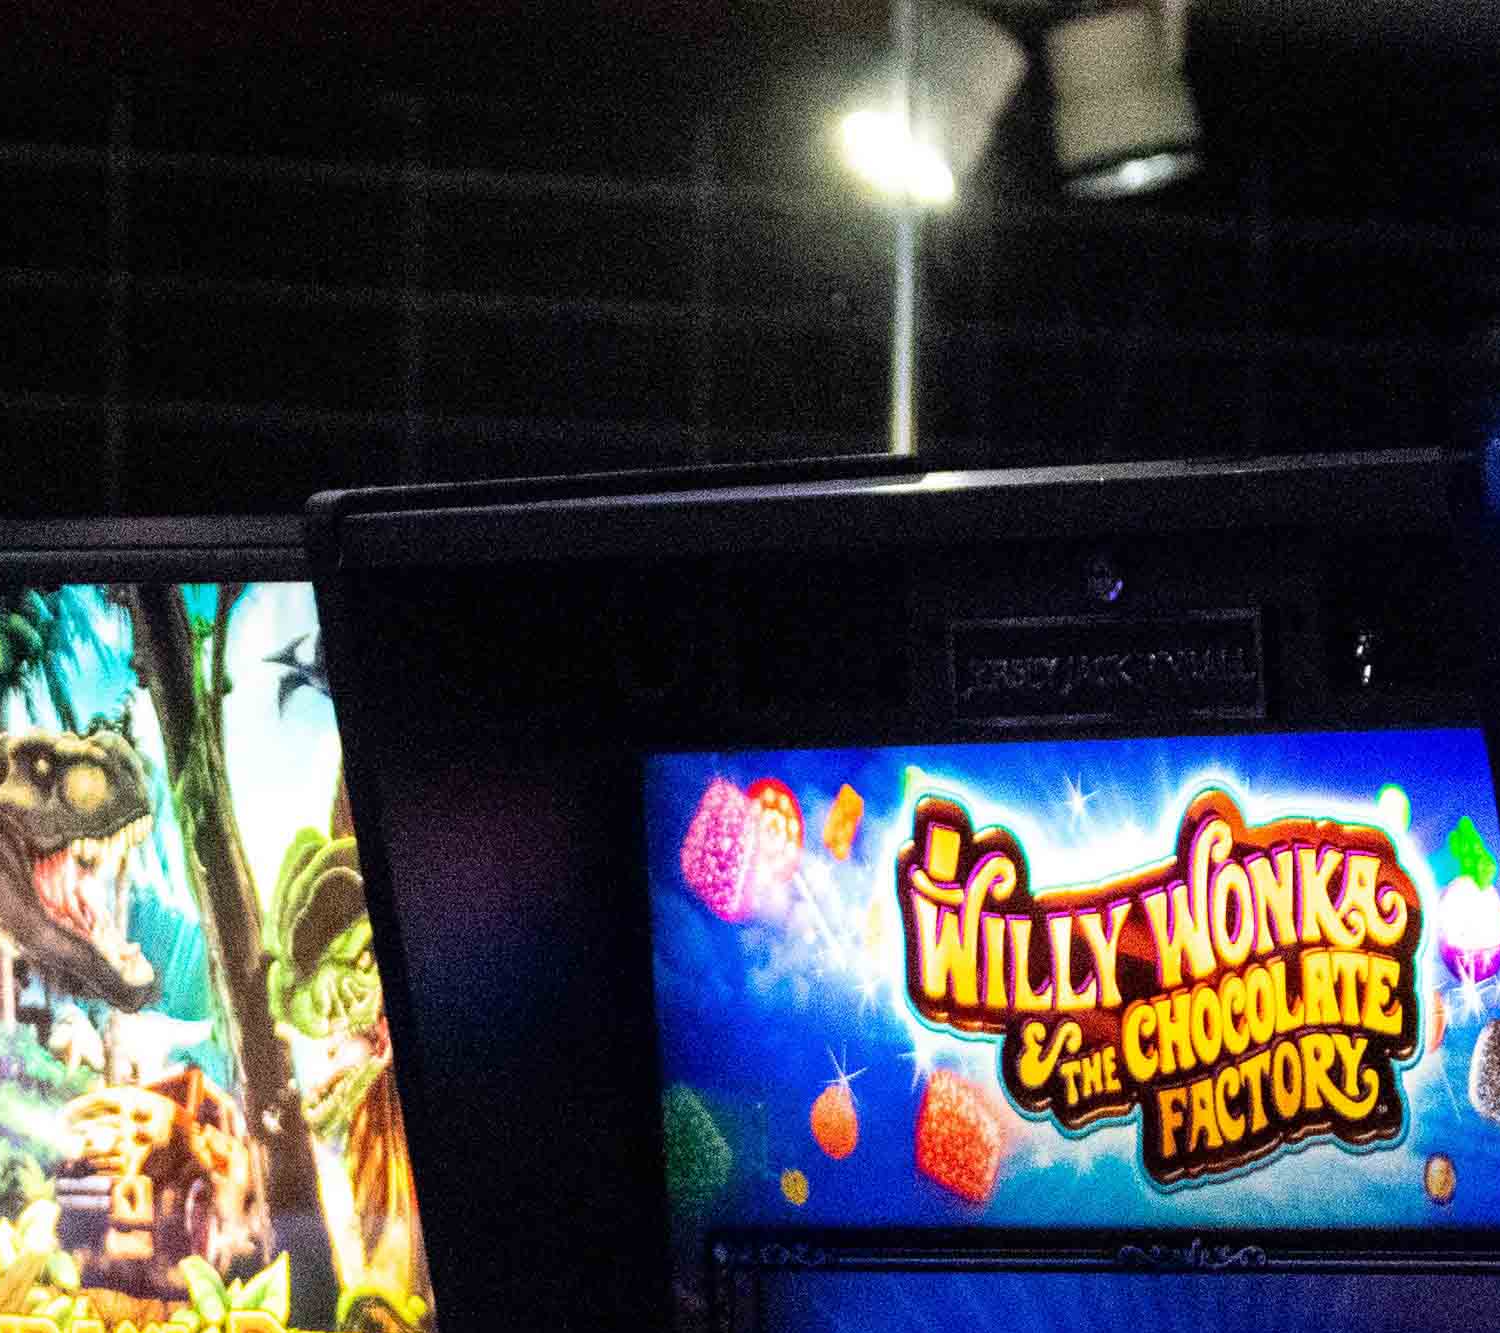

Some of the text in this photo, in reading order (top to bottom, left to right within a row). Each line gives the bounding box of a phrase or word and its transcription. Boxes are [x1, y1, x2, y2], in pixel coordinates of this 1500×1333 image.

[912, 817, 1410, 1014] WILLY WONKA
[1020, 950, 1405, 1100] & THE CHOCOLATE
[1160, 1034, 1380, 1160] FACTORY
